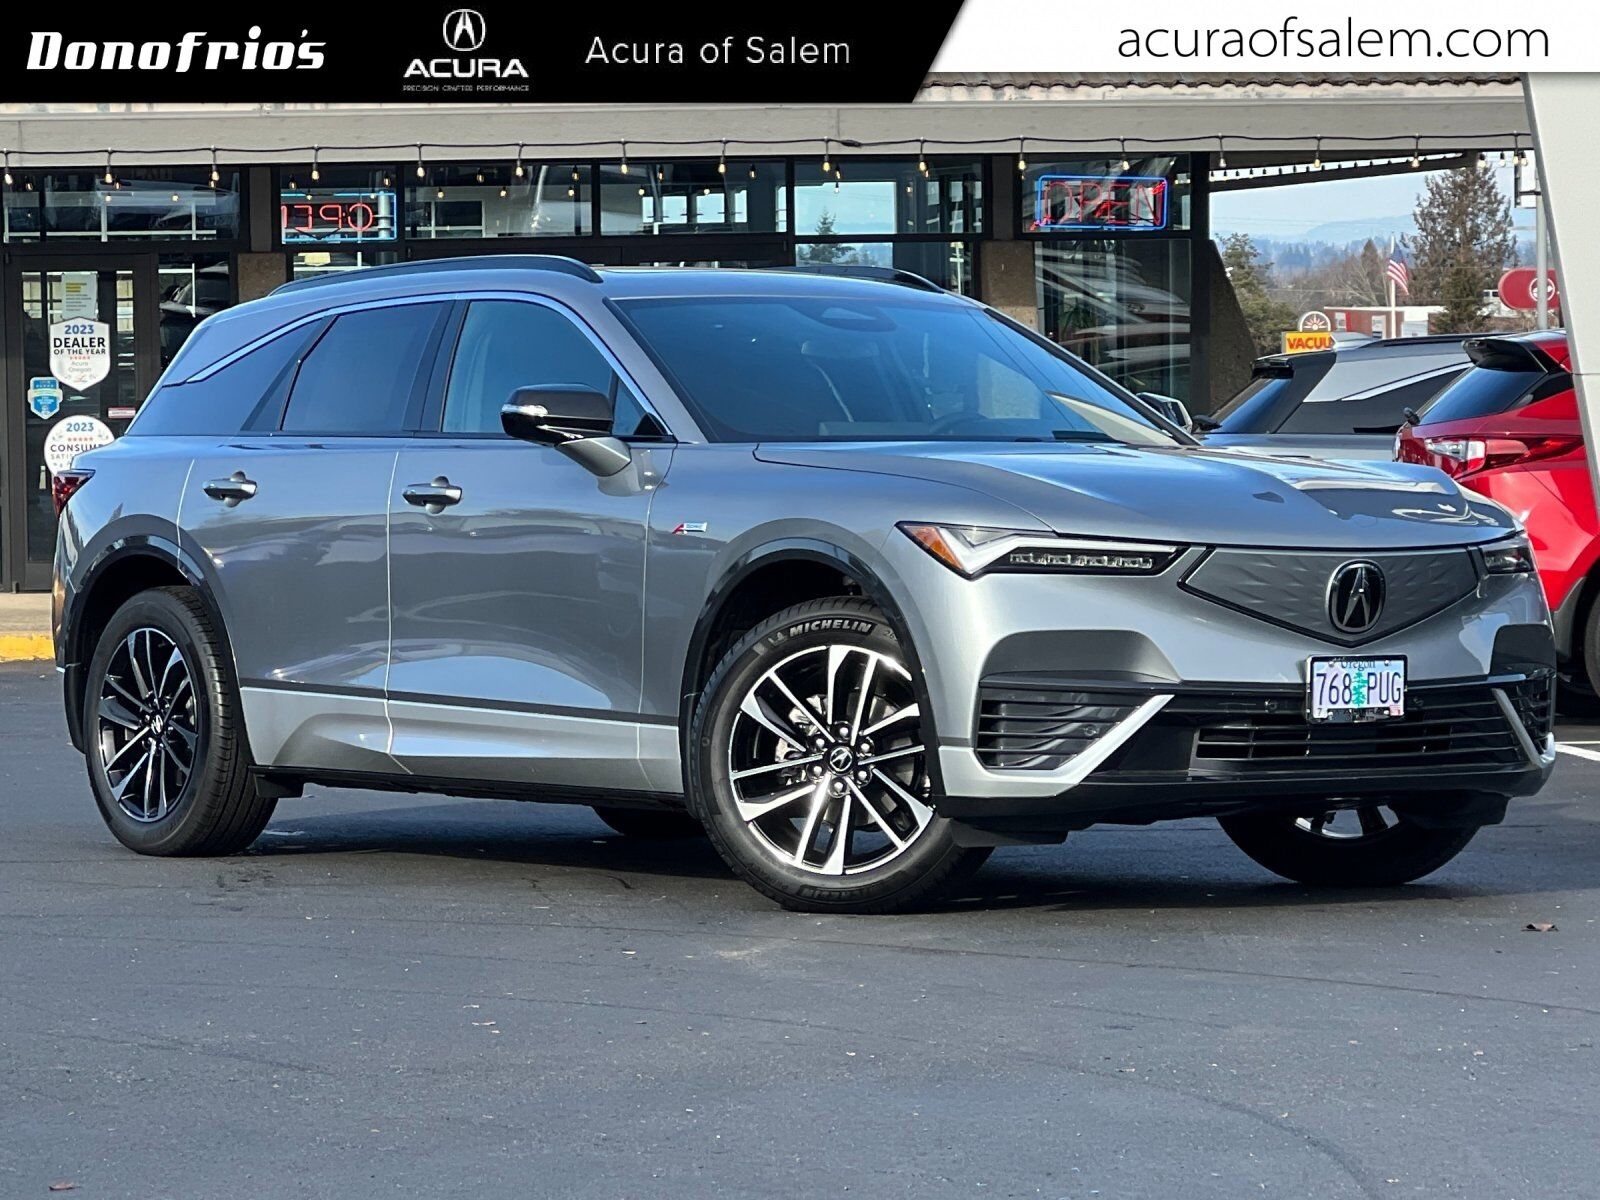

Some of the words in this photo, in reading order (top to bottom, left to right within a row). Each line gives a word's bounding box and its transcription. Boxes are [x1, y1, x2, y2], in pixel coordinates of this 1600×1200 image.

[64, 324, 94, 335] 2023
[53, 337, 106, 348] DEALER
[66, 422, 94, 432] 2023
[789, 619, 872, 637] MICHELIN
[1316, 673, 1352, 705] 768
[1367, 671, 1402, 704] PUG
